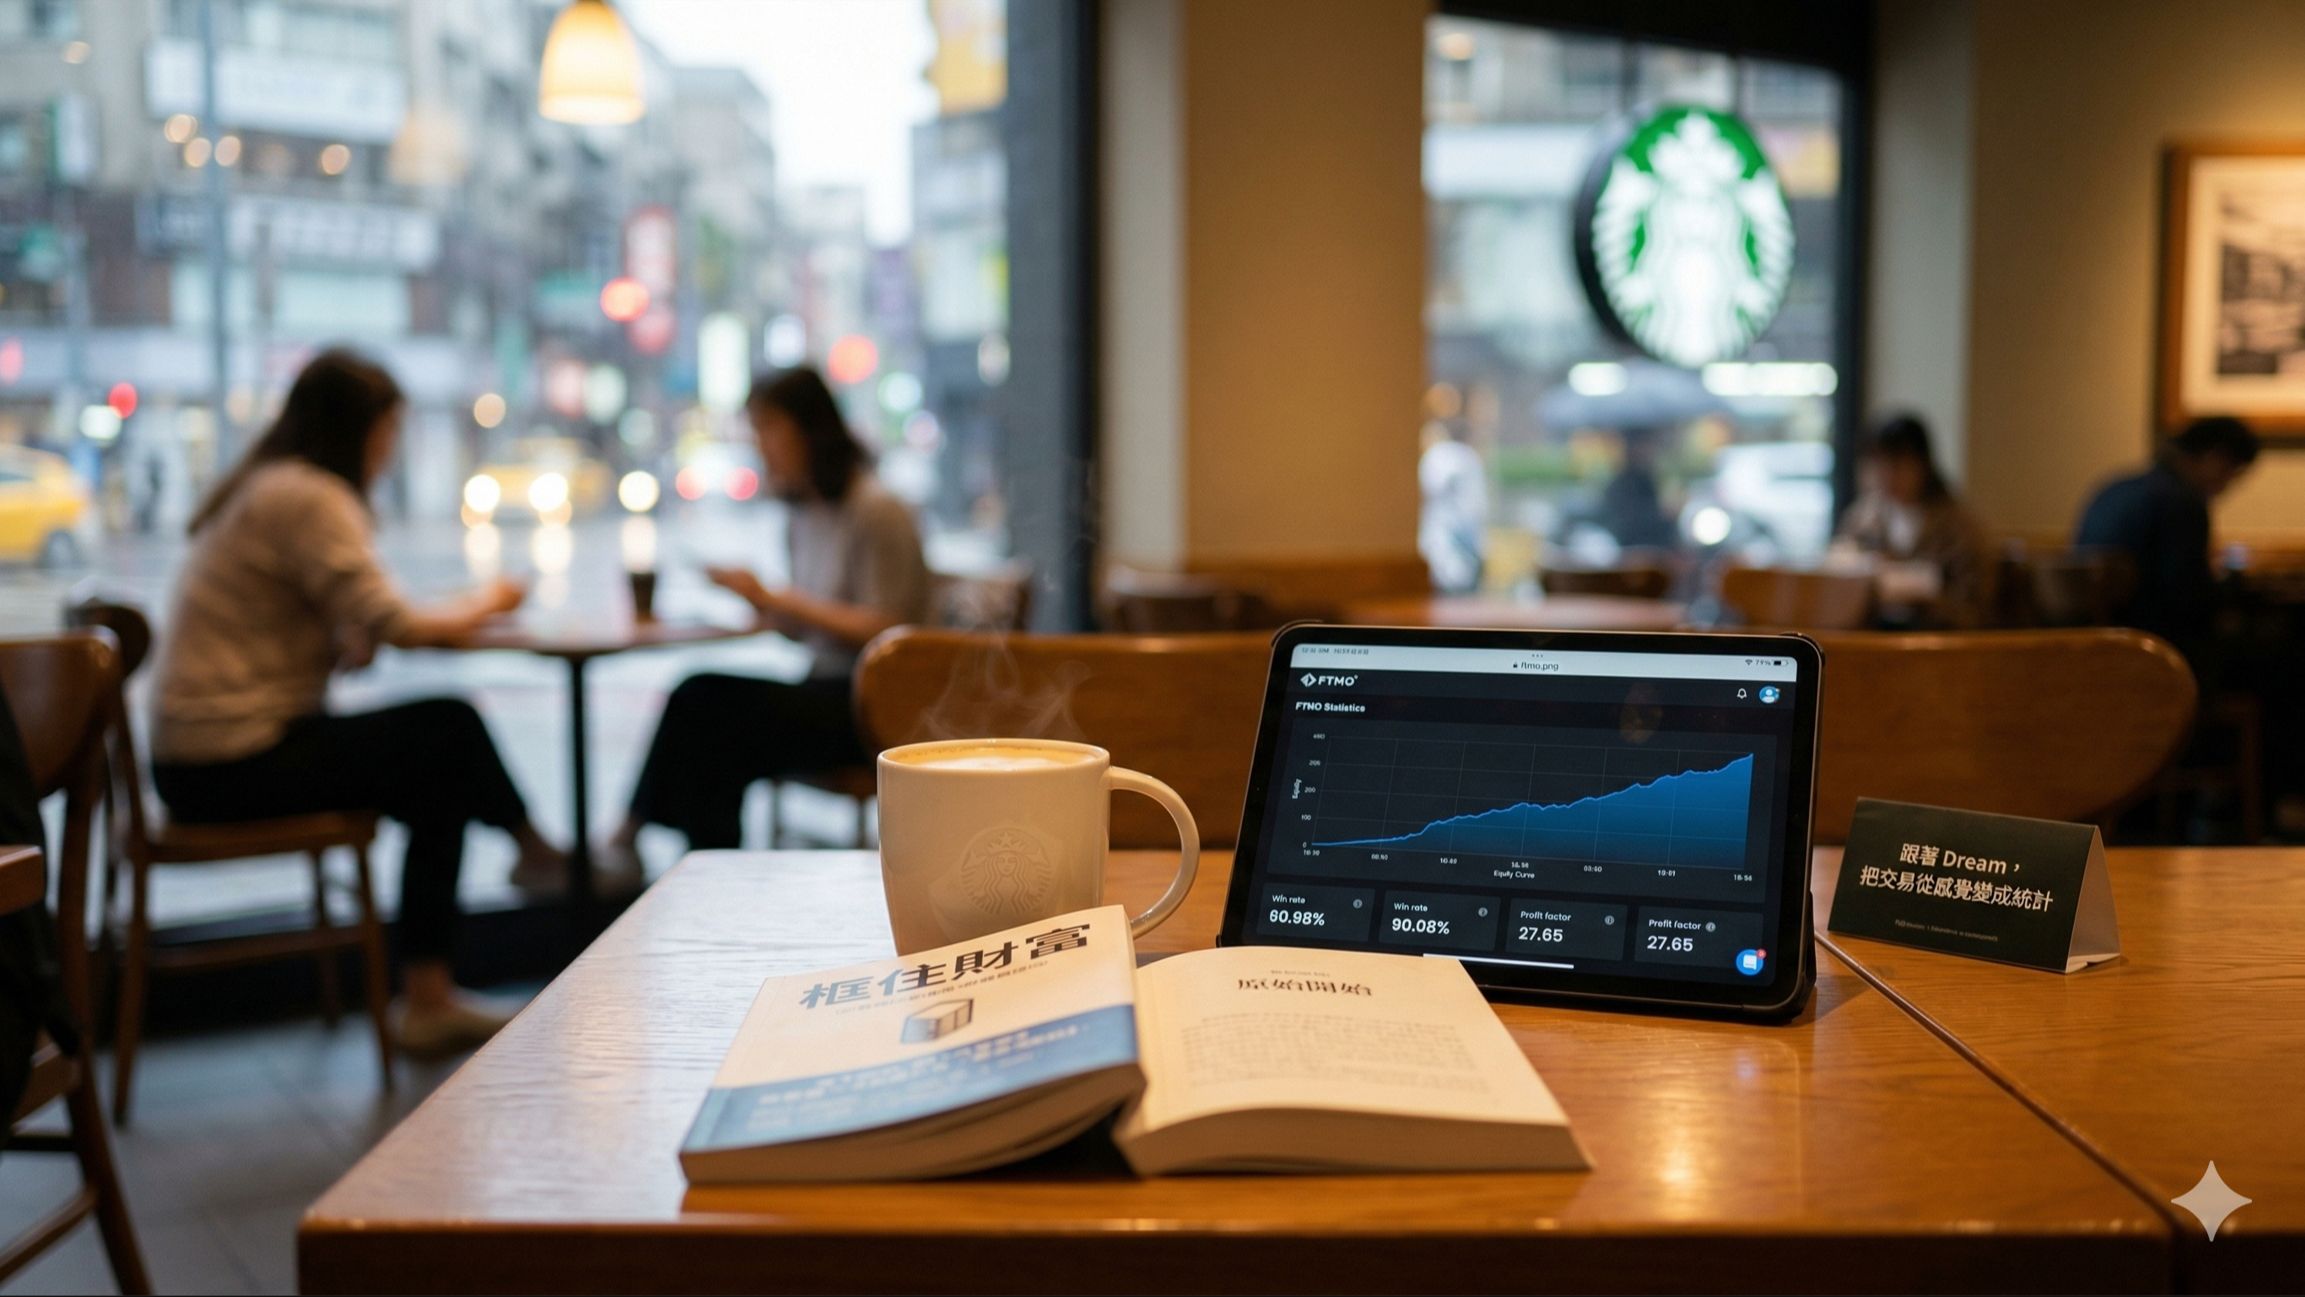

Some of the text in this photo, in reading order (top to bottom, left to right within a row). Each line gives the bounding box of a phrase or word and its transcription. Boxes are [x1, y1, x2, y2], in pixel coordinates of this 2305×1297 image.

[1318, 675, 1355, 687] FTMO
[1900, 843, 1940, 867] 跟著
[1859, 864, 2054, 913] 把交易從感覺變成統計
[1272, 894, 1306, 904] Win rate
[1393, 902, 1429, 912] Win rate
[1269, 909, 1325, 926] 60.98%
[1520, 910, 1571, 921] Profit factor
[1392, 917, 1450, 935] 90.08%
[1649, 919, 1701, 930] Profit factor
[1518, 926, 1564, 943] 27.65
[1647, 935, 1694, 952] 27.65
[799, 923, 1091, 1009] 框住財富
